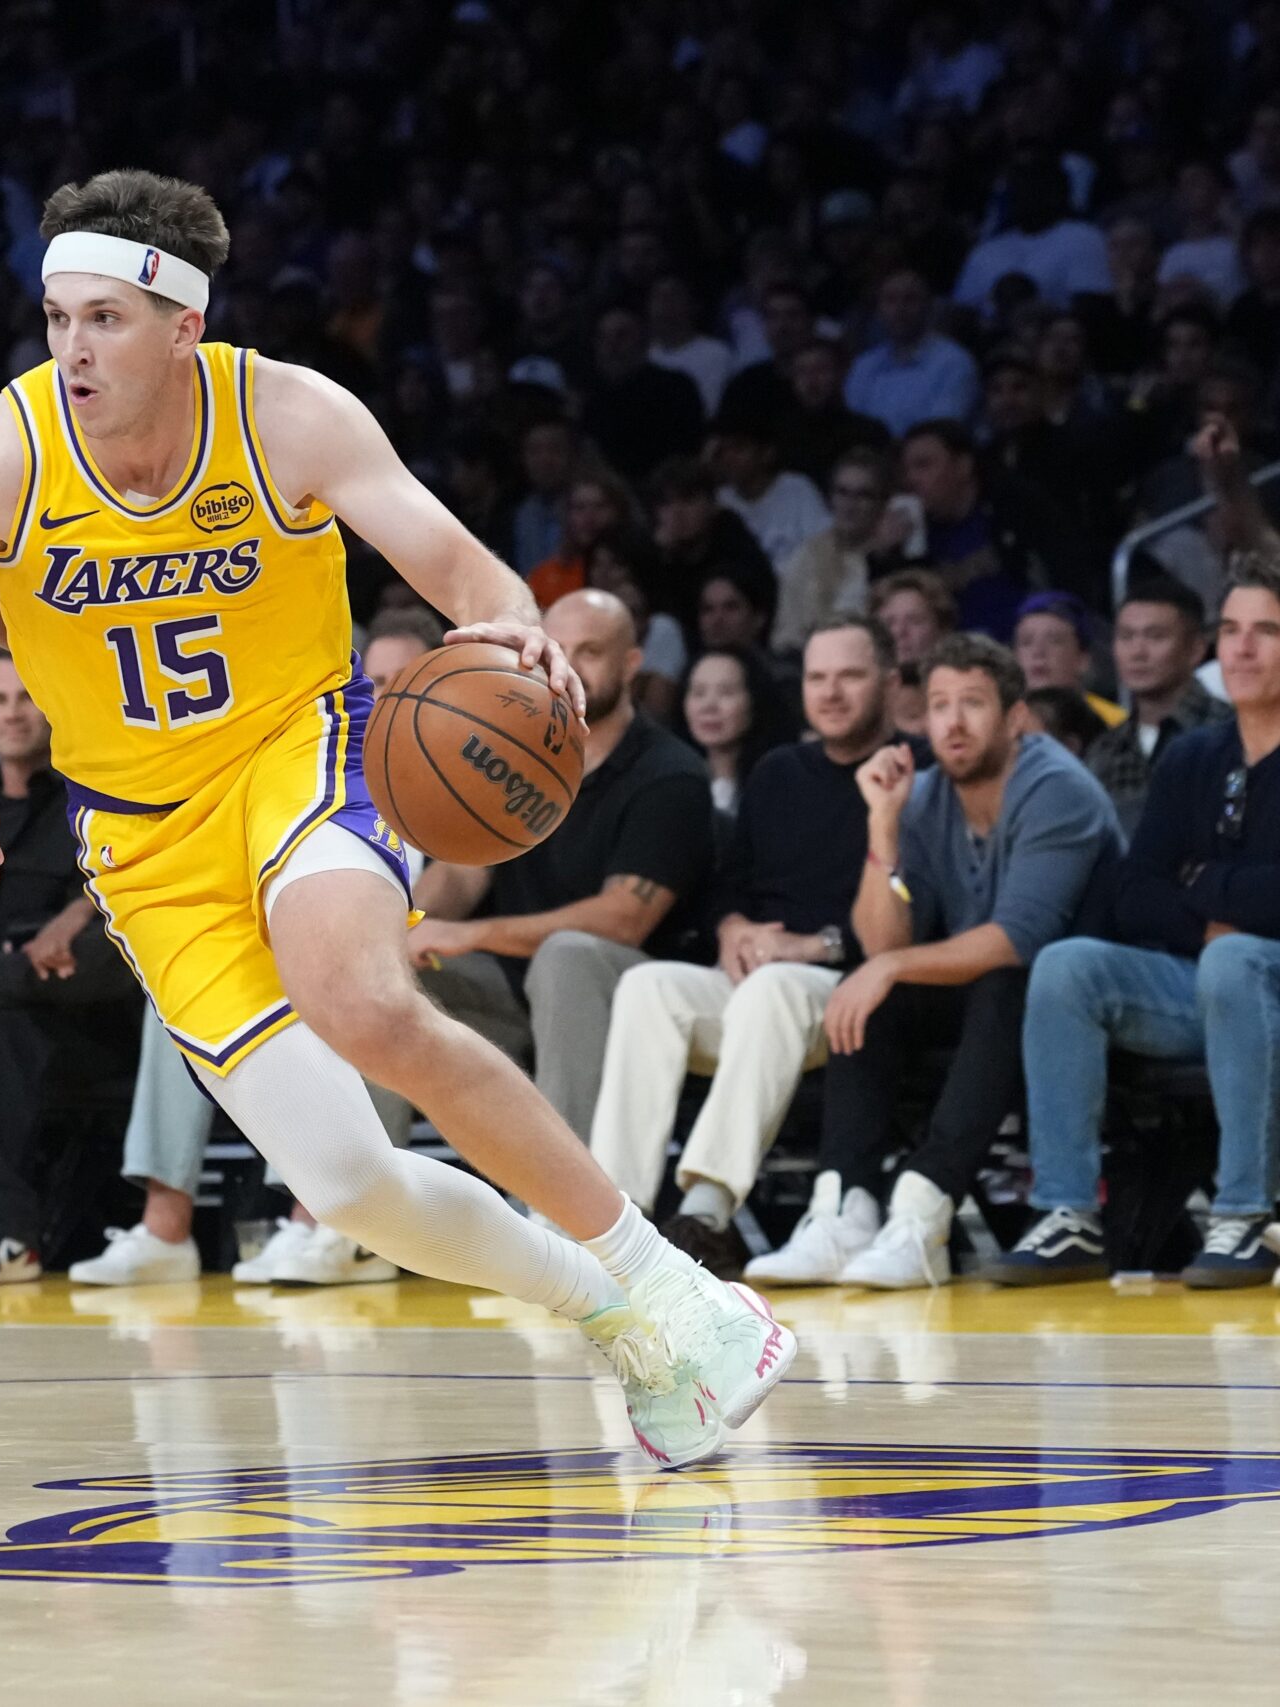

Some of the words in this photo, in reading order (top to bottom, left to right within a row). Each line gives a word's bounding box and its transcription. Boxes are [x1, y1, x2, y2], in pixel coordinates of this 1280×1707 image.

[195, 495, 250, 518] bibigo
[34, 537, 263, 616] LAKERS
[104, 613, 235, 731] 15
[461, 732, 563, 836] Wilson
